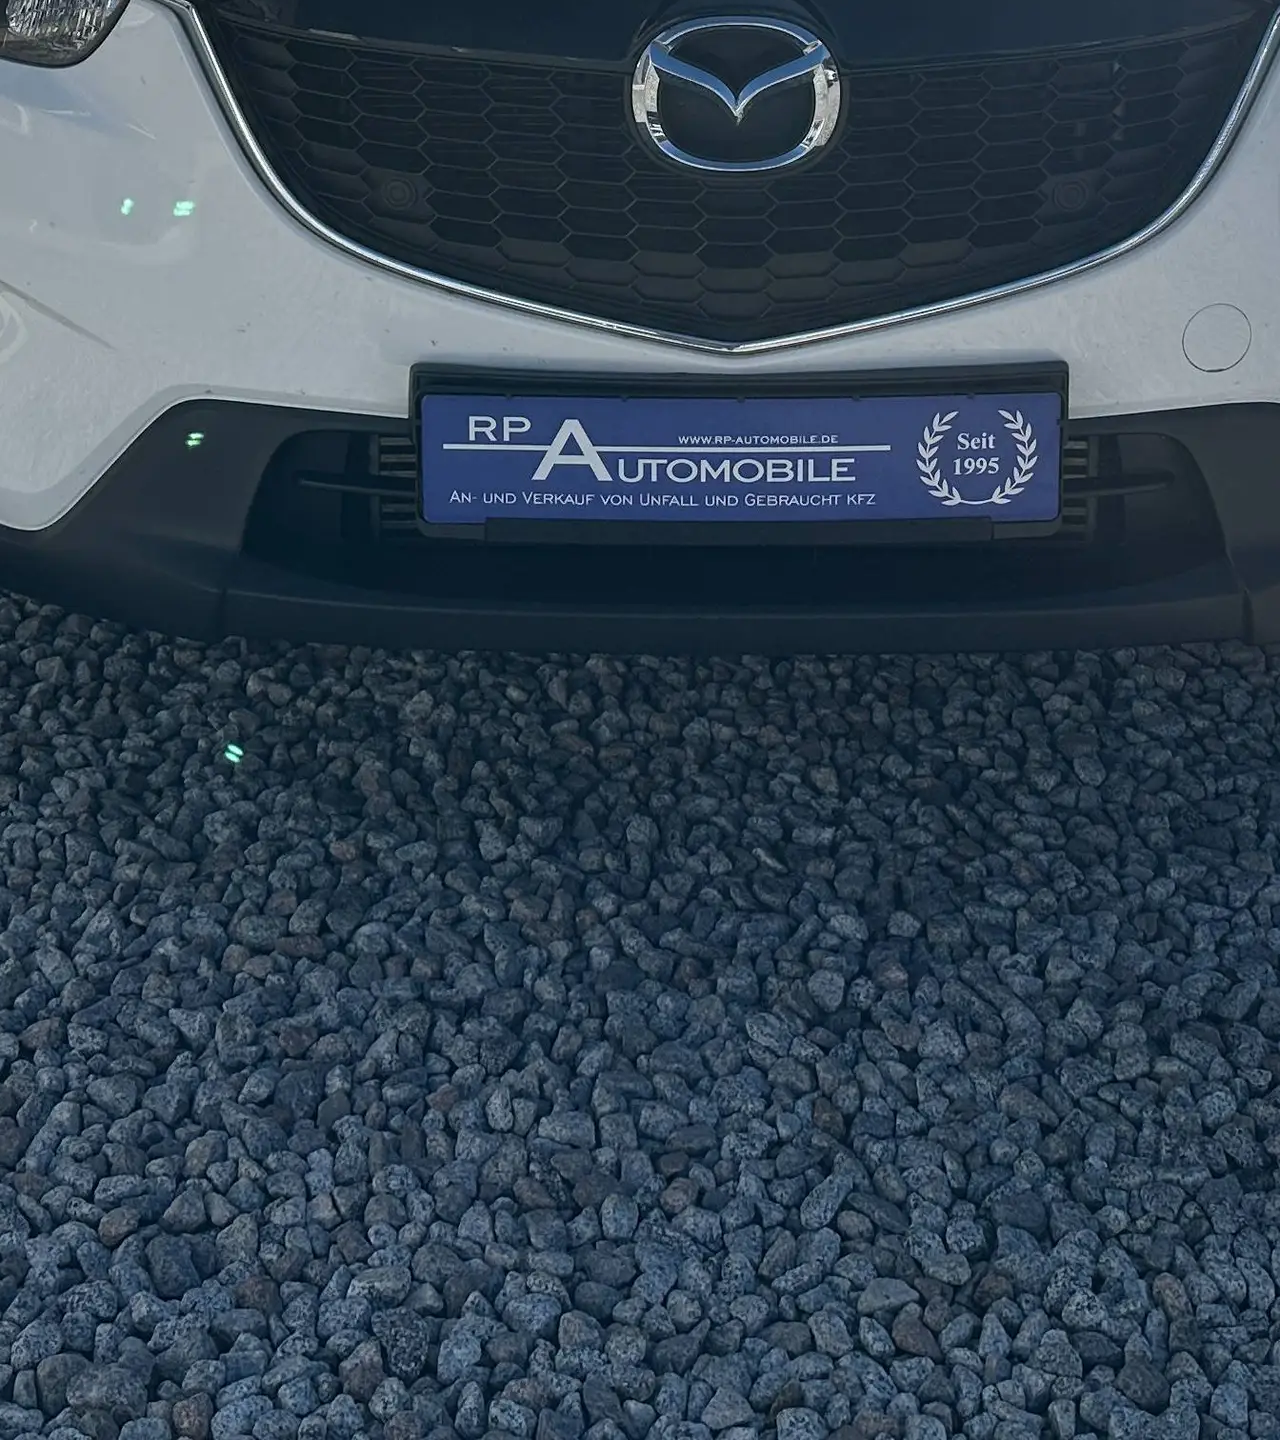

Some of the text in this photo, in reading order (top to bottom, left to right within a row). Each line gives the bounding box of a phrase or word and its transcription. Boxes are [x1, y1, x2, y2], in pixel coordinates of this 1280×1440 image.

[678, 434, 838, 445] WWW.RP-AUTOMOBILE.DE
[957, 432, 996, 450] Seit
[468, 415, 856, 484] RP AUTOMOBILE
[952, 456, 1000, 475] 1995
[449, 490, 876, 507] AN- UND VERKAUF VON UNFALL UND GEBRAUCHT KFZ
